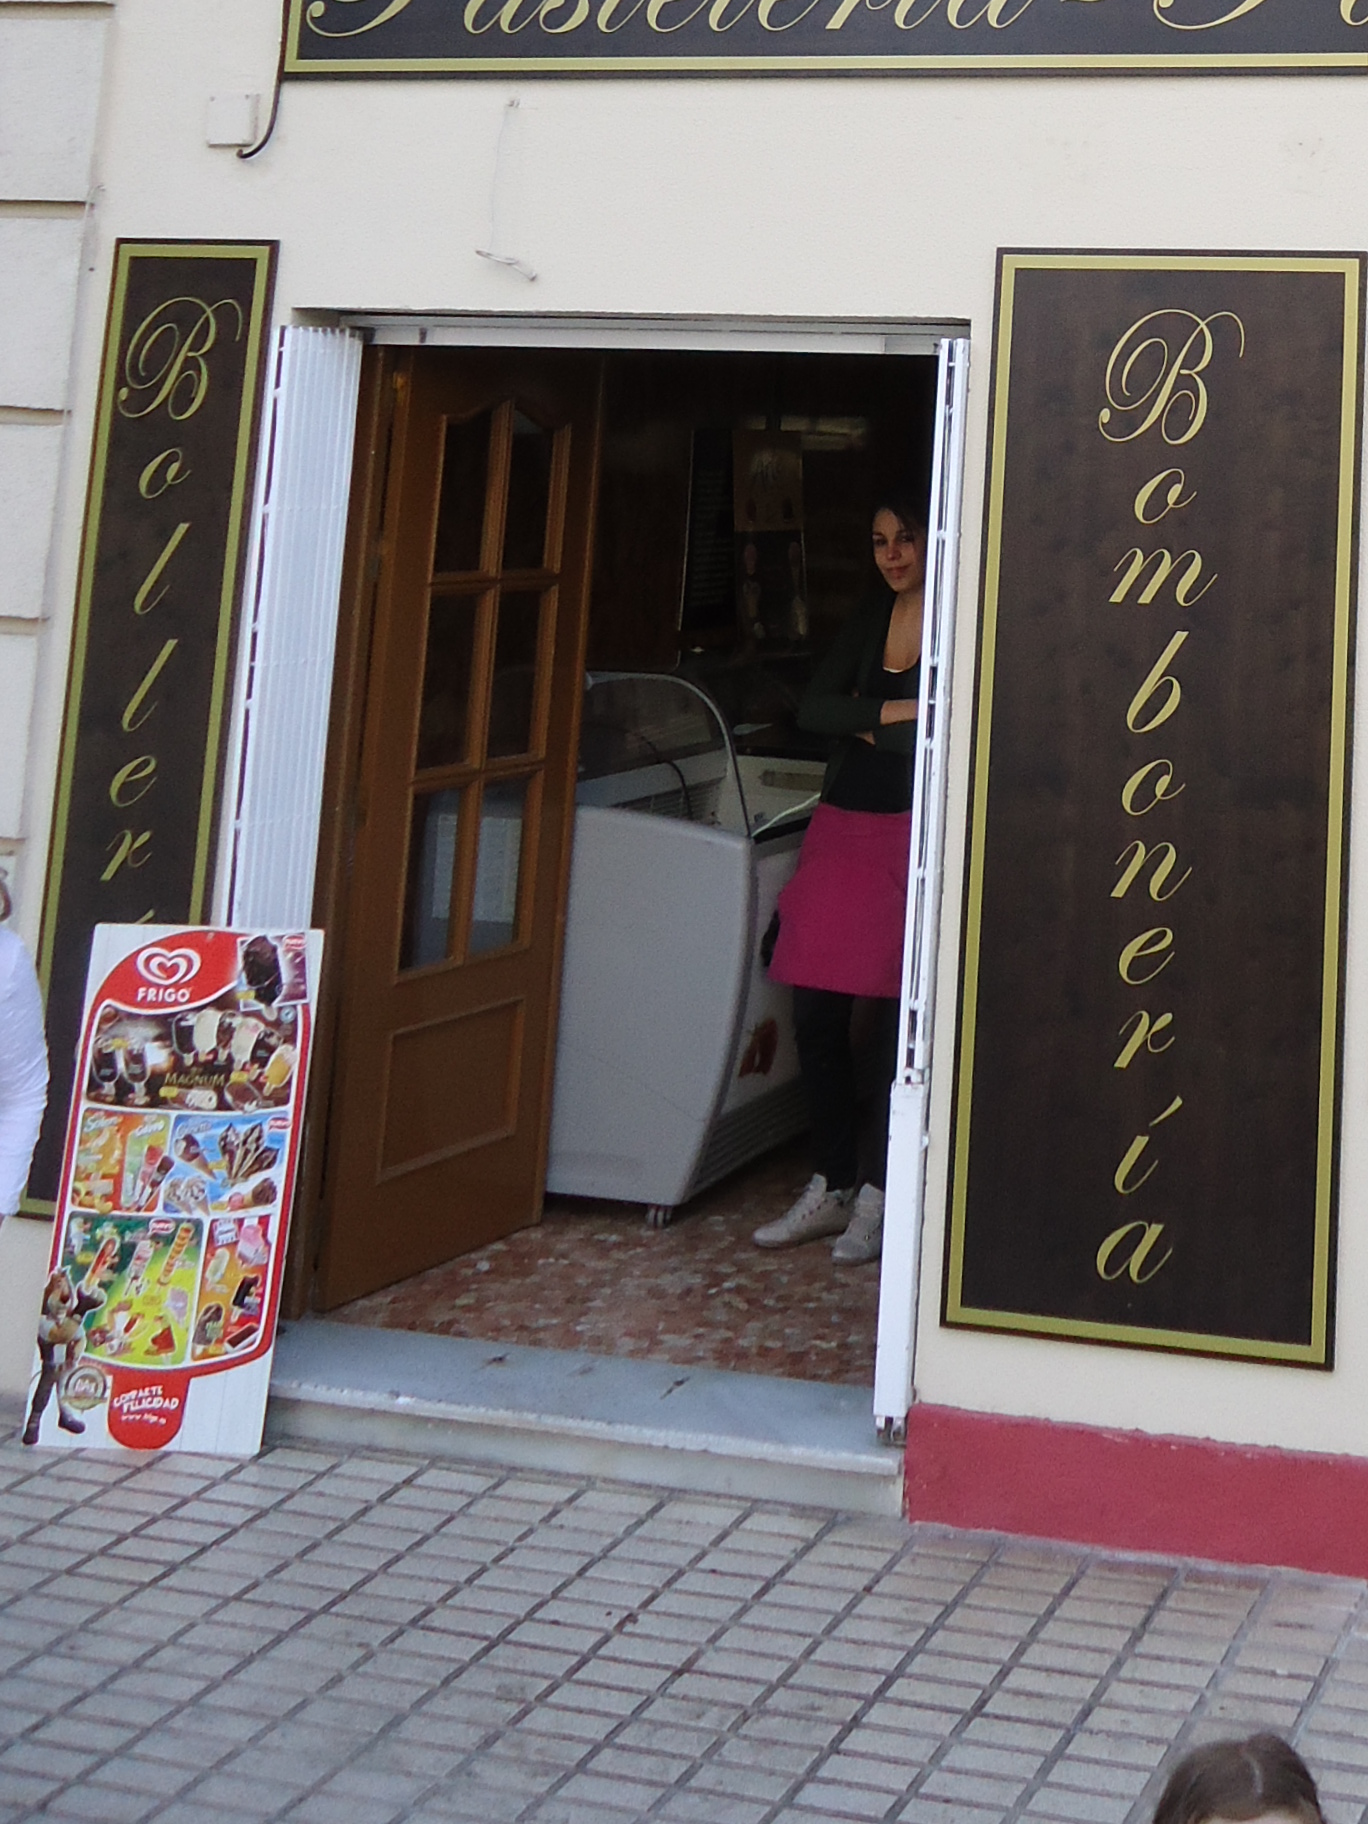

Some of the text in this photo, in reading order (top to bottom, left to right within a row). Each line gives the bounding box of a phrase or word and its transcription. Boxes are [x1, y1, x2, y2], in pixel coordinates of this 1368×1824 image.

[100, 295, 242, 924] Boller
[1096, 307, 1246, 1284] Bombonería
[137, 987, 191, 1003] FRIGO
